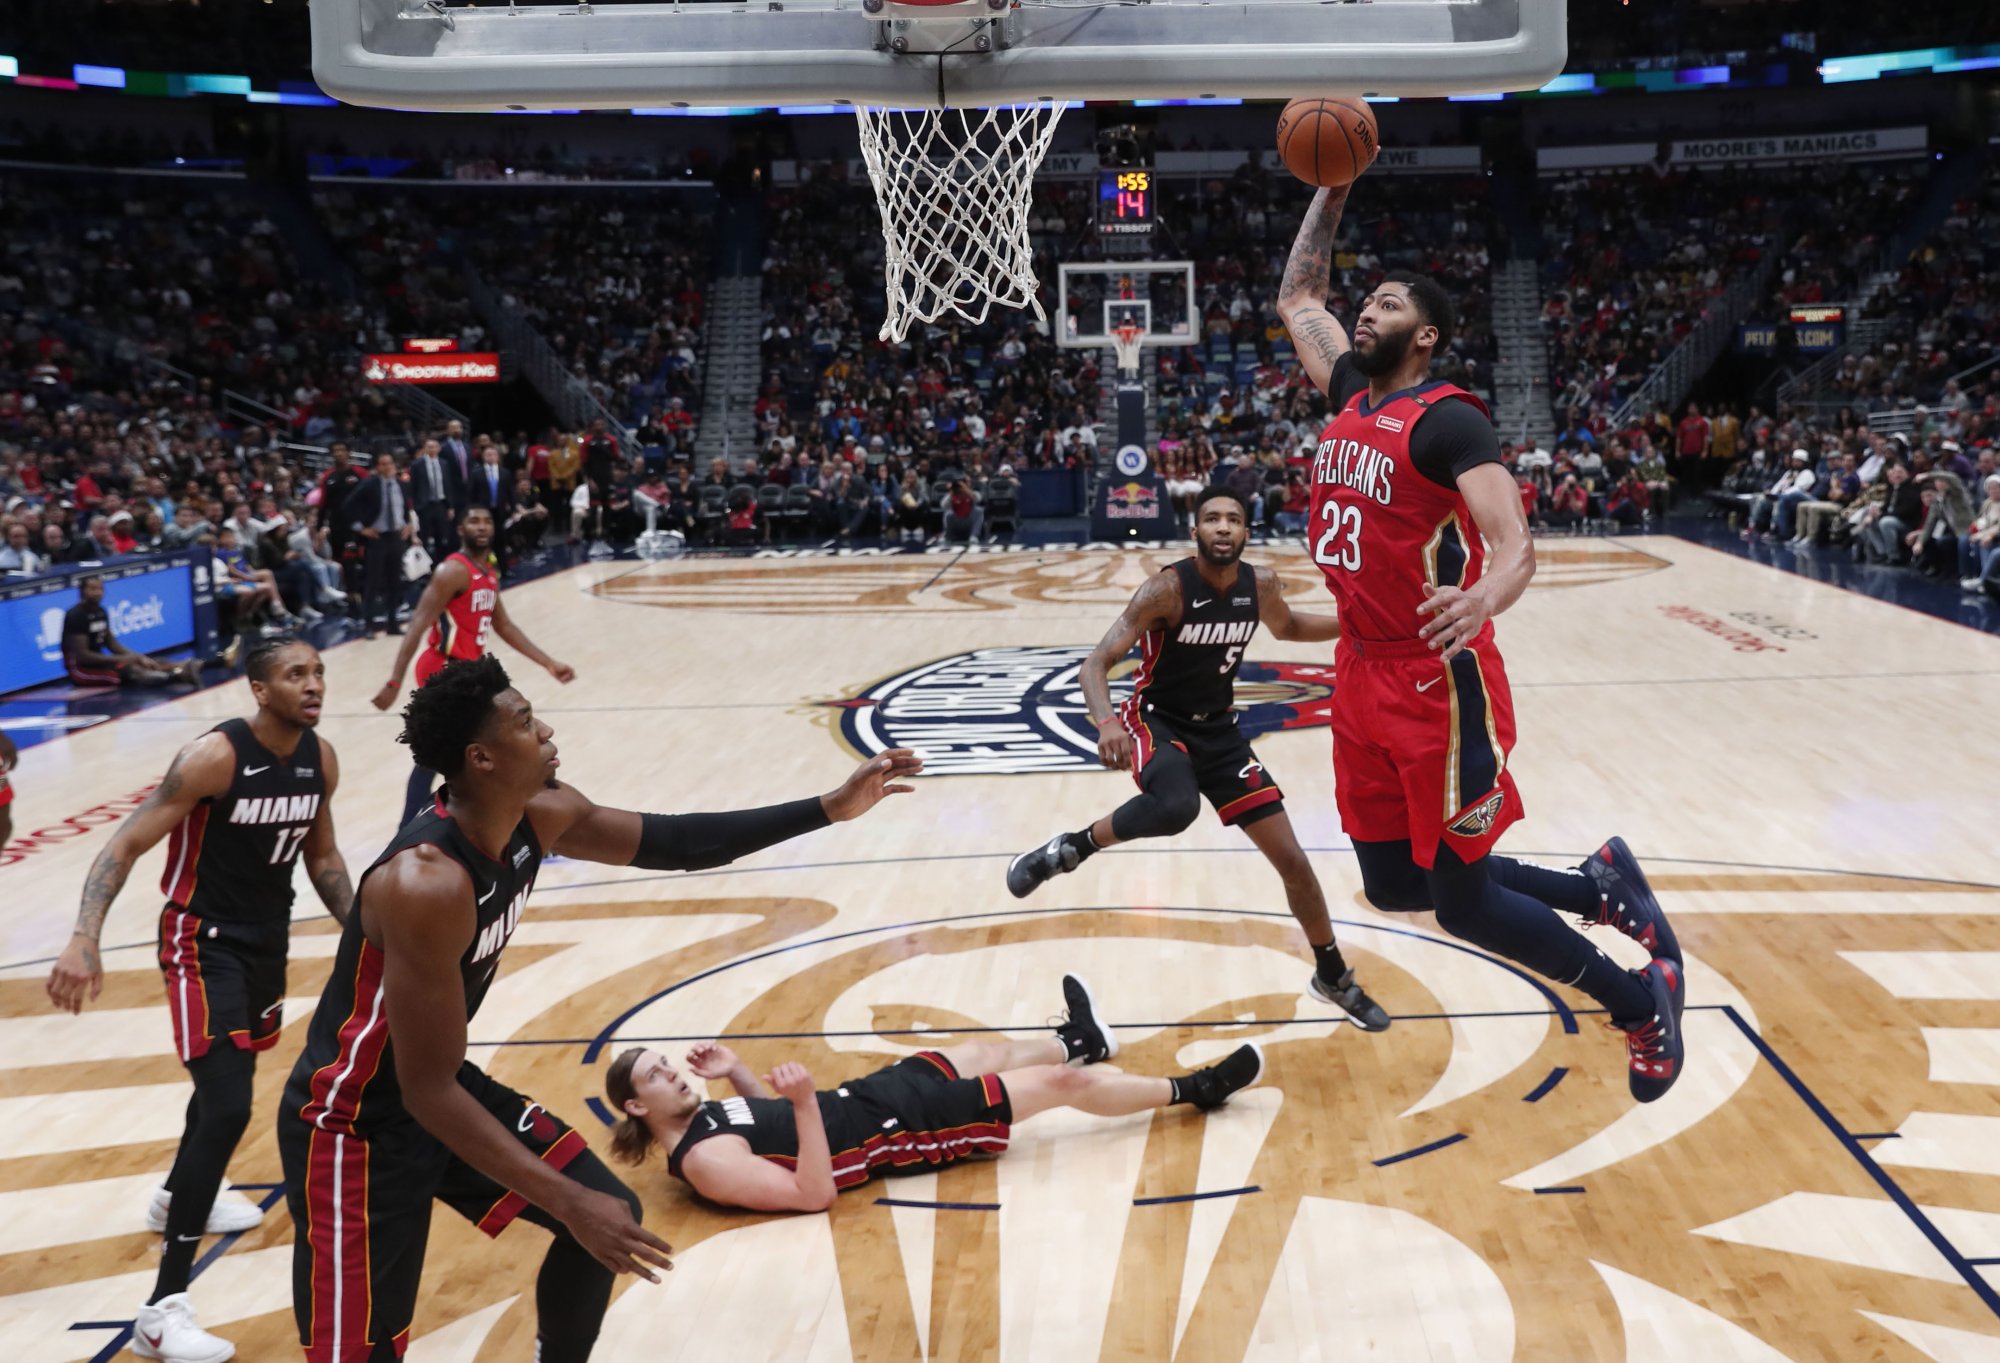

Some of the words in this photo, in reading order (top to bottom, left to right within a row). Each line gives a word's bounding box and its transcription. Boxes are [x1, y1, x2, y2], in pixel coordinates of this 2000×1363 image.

[1683, 139, 1777, 159] MOORE'S
[1783, 133, 1878, 154] MANIACS
[1117, 172, 1148, 191] 1:55
[1117, 191, 1145, 218] 14
[1113, 223, 1153, 233] TISSOT
[391, 362, 460, 379] SMOOTHIE
[462, 361, 497, 378] KING
[1311, 438, 1395, 506] PELICANS
[1315, 499, 1363, 572] 23
[1176, 621, 1255, 645] MIAMI
[1219, 645, 1243, 674] 5
[228, 794, 320, 825] MIAMI
[268, 826, 311, 865] 17
